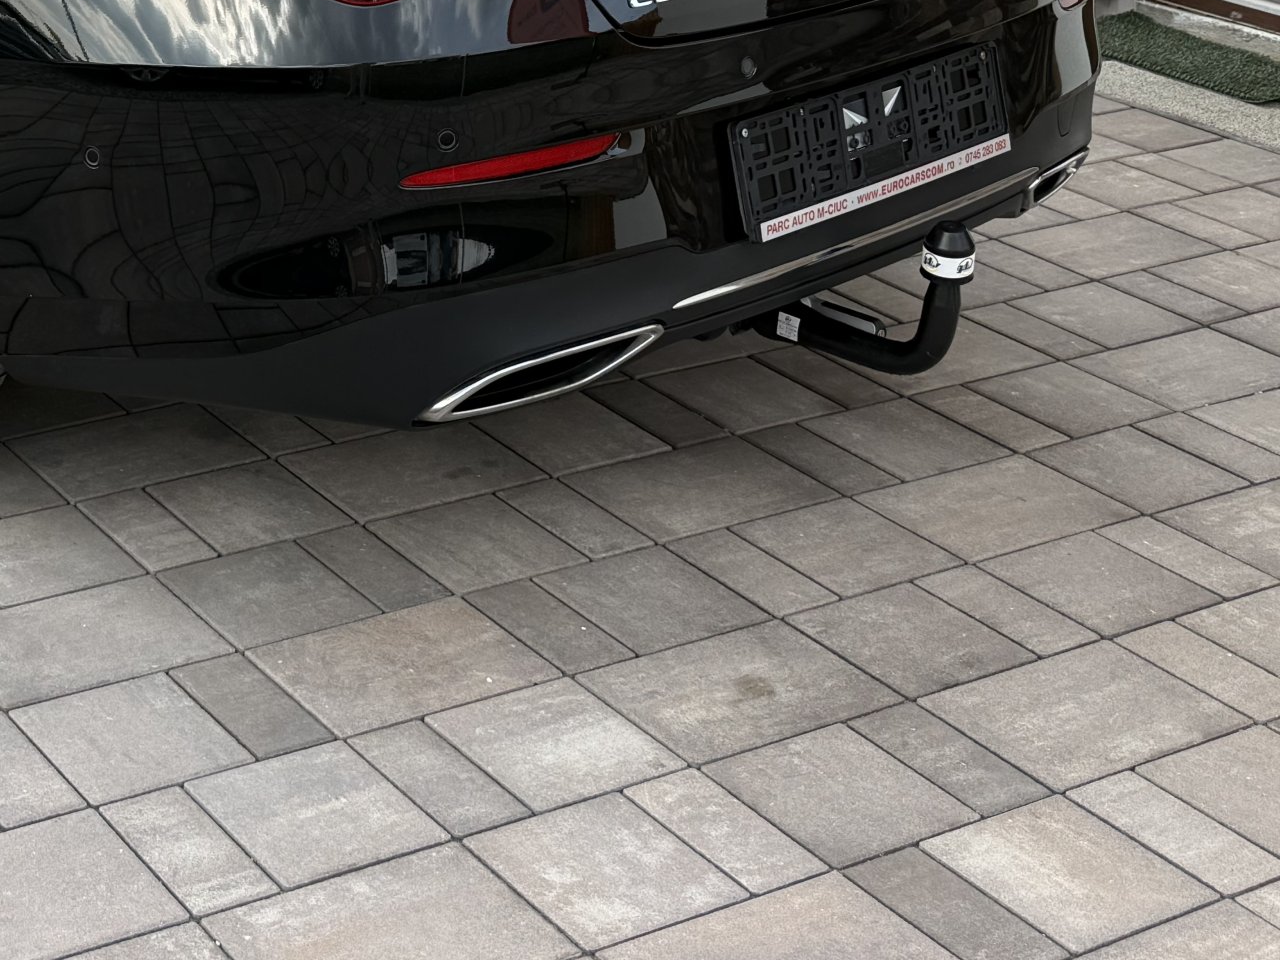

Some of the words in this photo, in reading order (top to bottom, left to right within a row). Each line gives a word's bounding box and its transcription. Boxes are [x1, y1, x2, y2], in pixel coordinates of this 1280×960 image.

[766, 218, 790, 236] PARC
[792, 210, 815, 227] AUTO
[817, 198, 848, 218] M-CIUC
[965, 148, 981, 164] 0745
[981, 143, 994, 157] 283
